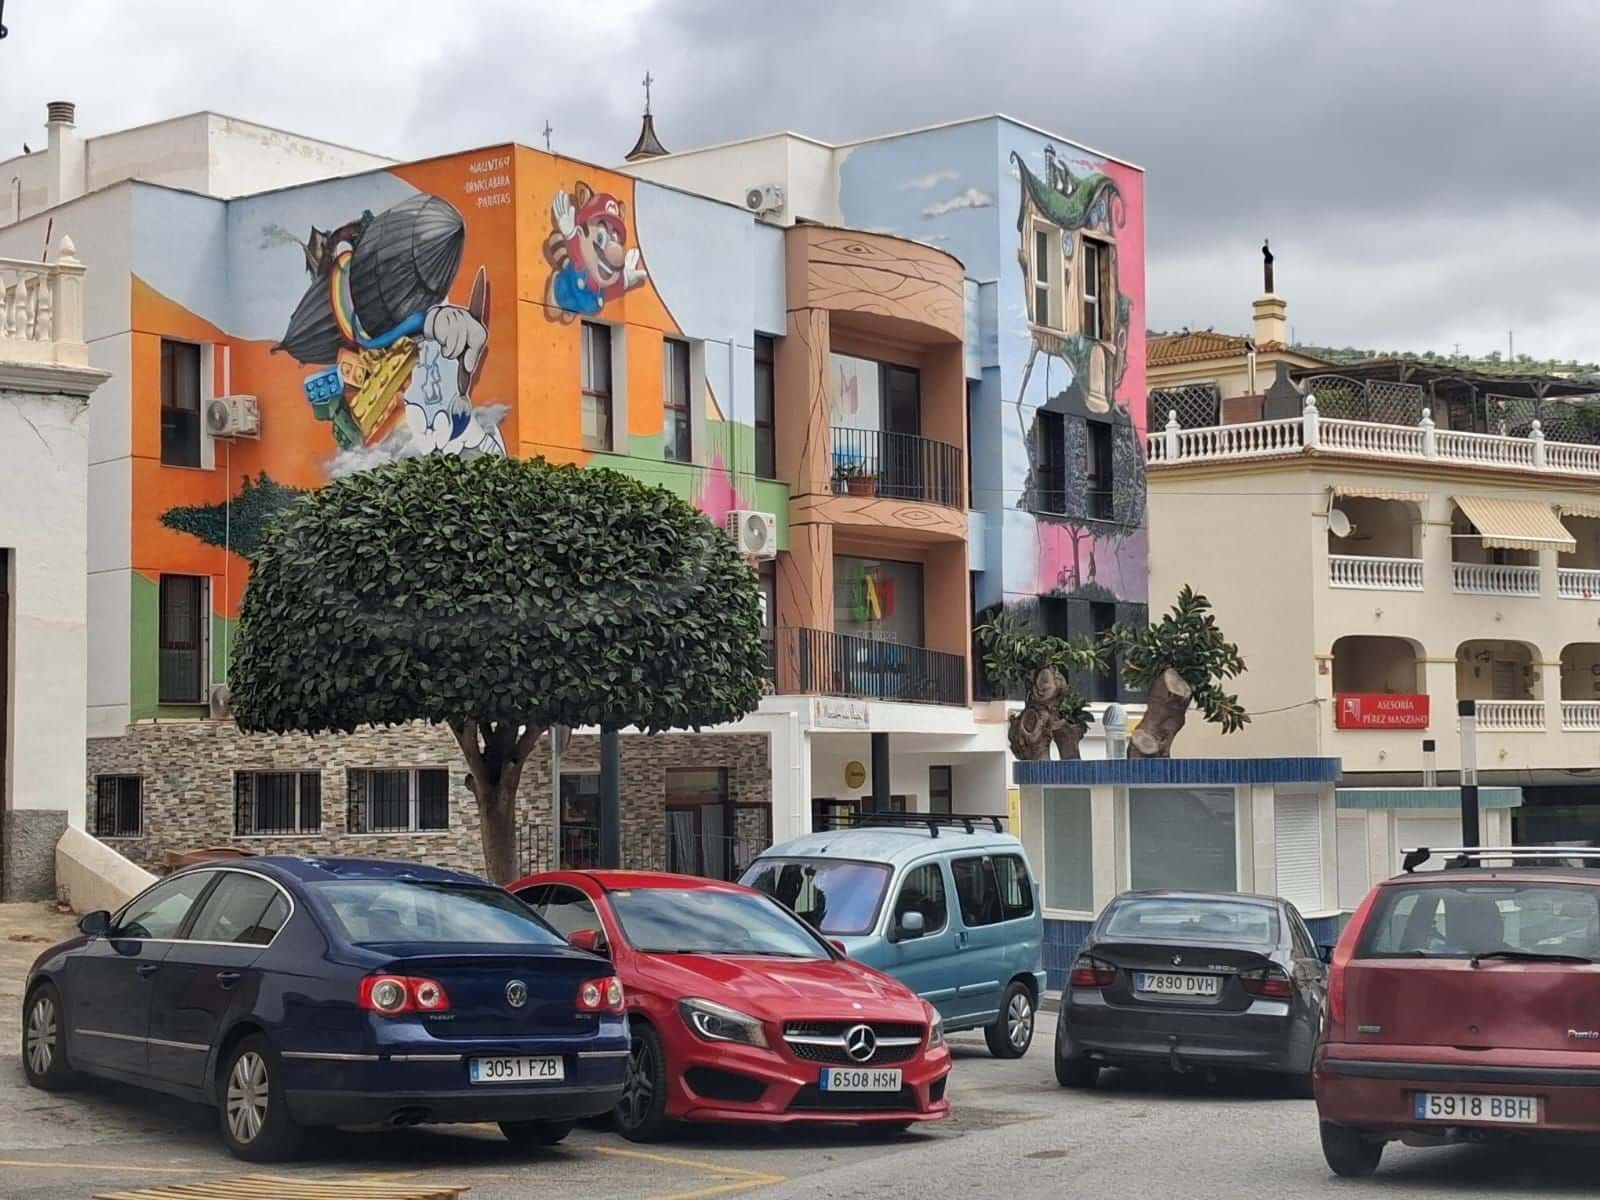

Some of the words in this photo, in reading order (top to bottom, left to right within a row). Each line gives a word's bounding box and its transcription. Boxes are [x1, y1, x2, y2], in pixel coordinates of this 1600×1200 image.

[1377, 700, 1414, 710] ASESORÍA
[1387, 714, 1427, 725] MANZANO
[1147, 976, 1182, 989] 7890
[1187, 978, 1214, 991] DVH
[486, 1060, 523, 1077] 3051
[529, 1059, 557, 1076] FZB
[833, 1072, 869, 1087] 6508
[873, 1073, 897, 1088] HSH
[1430, 1096, 1483, 1116] 5918
[1490, 1098, 1531, 1119] BBH
